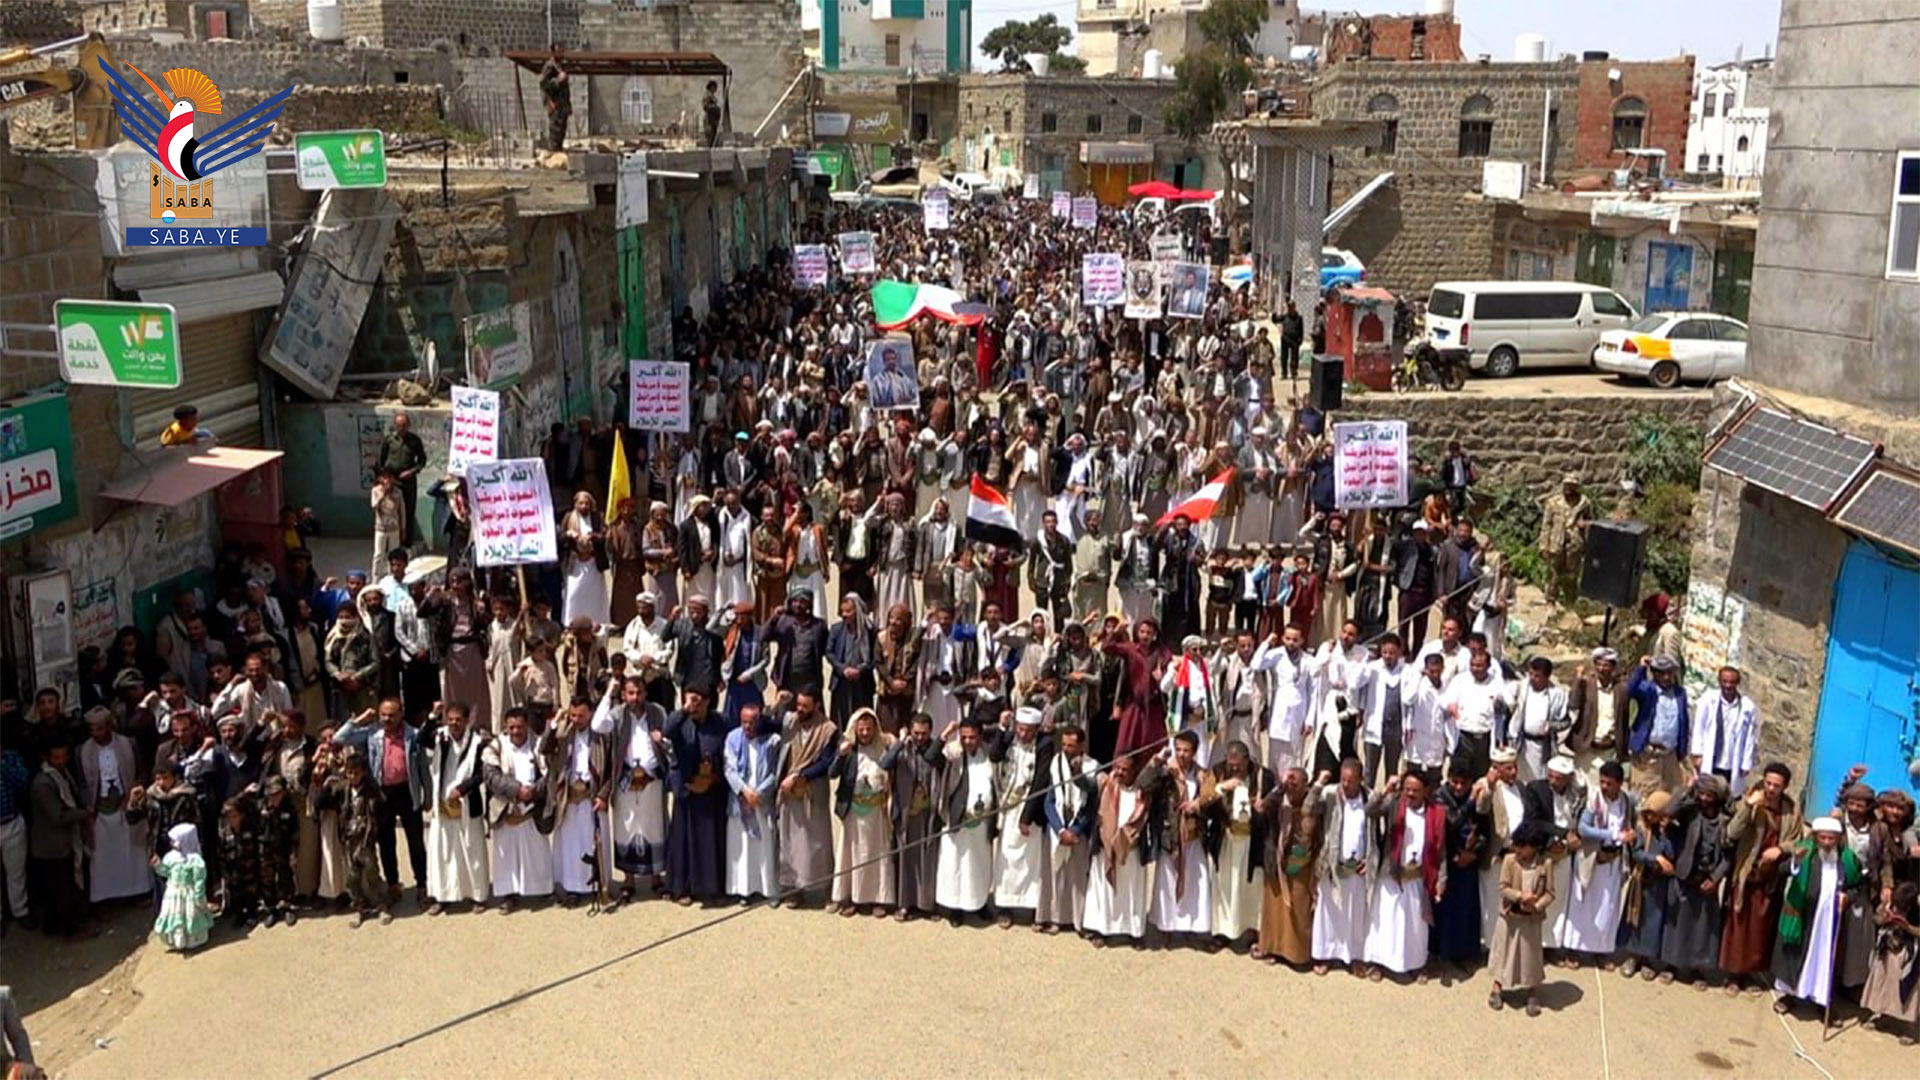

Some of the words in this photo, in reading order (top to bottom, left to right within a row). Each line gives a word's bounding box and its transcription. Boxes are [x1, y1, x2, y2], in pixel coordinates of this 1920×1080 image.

[1, 81, 28, 99] CAT
[473, 464, 507, 489] أكبر
[511, 466, 534, 482] الله
[0, 467, 52, 511] مخز
